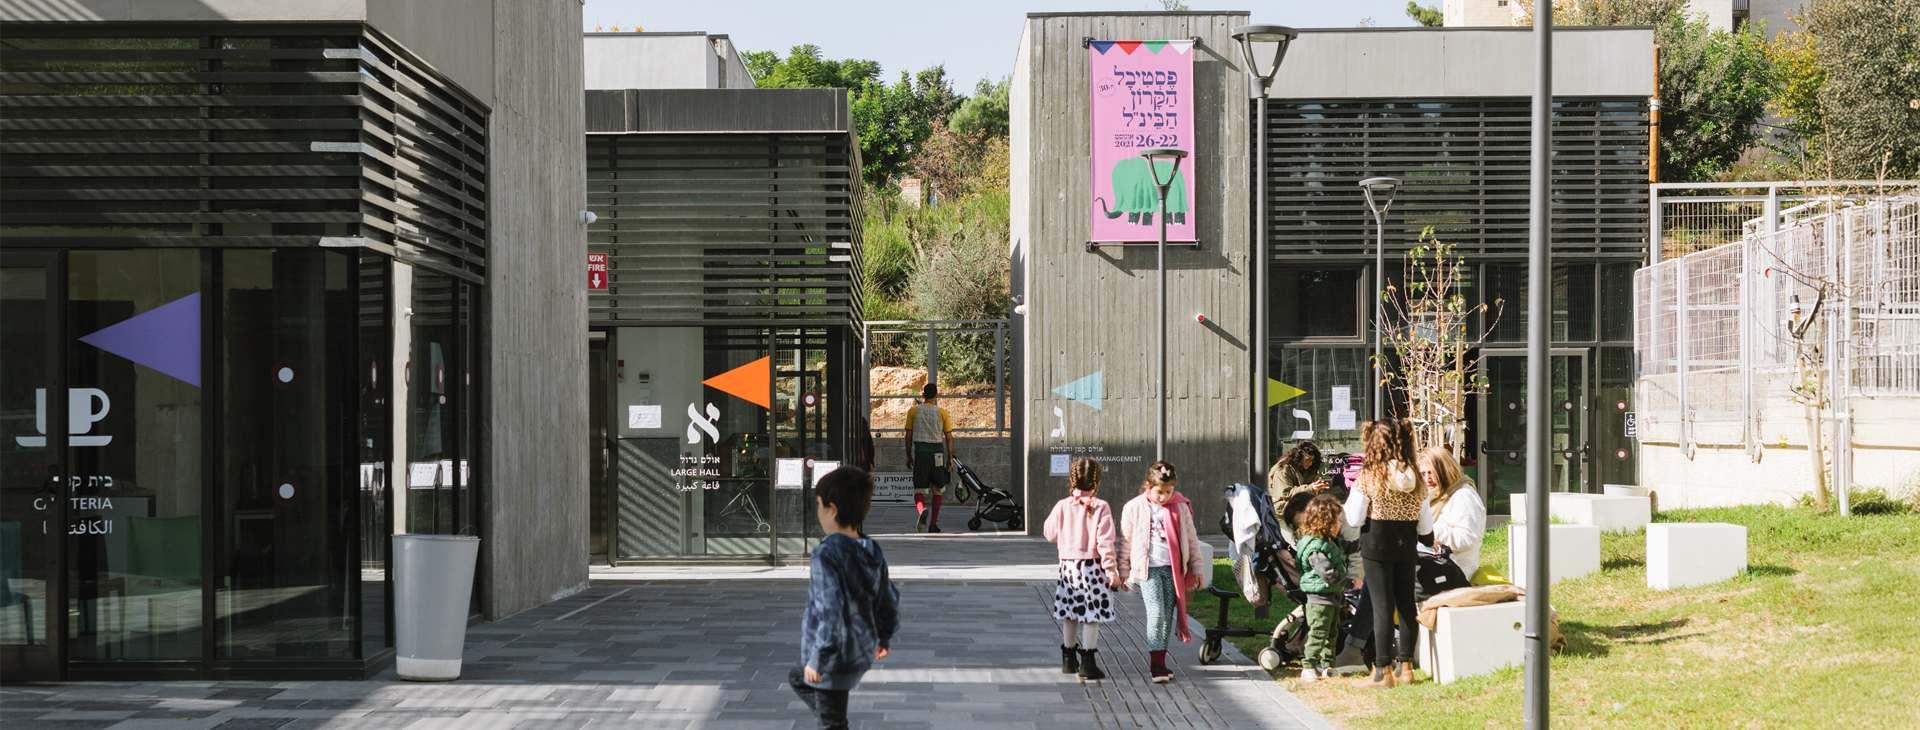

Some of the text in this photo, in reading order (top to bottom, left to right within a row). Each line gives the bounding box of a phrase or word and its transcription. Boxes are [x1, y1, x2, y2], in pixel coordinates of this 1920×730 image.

[1136, 134, 1178, 147] 26-22
[687, 402, 720, 444] א
[680, 454, 720, 464] אולם גדול
[88, 476, 113, 487] בית
[676, 481, 720, 492] قاعة كبيرة
